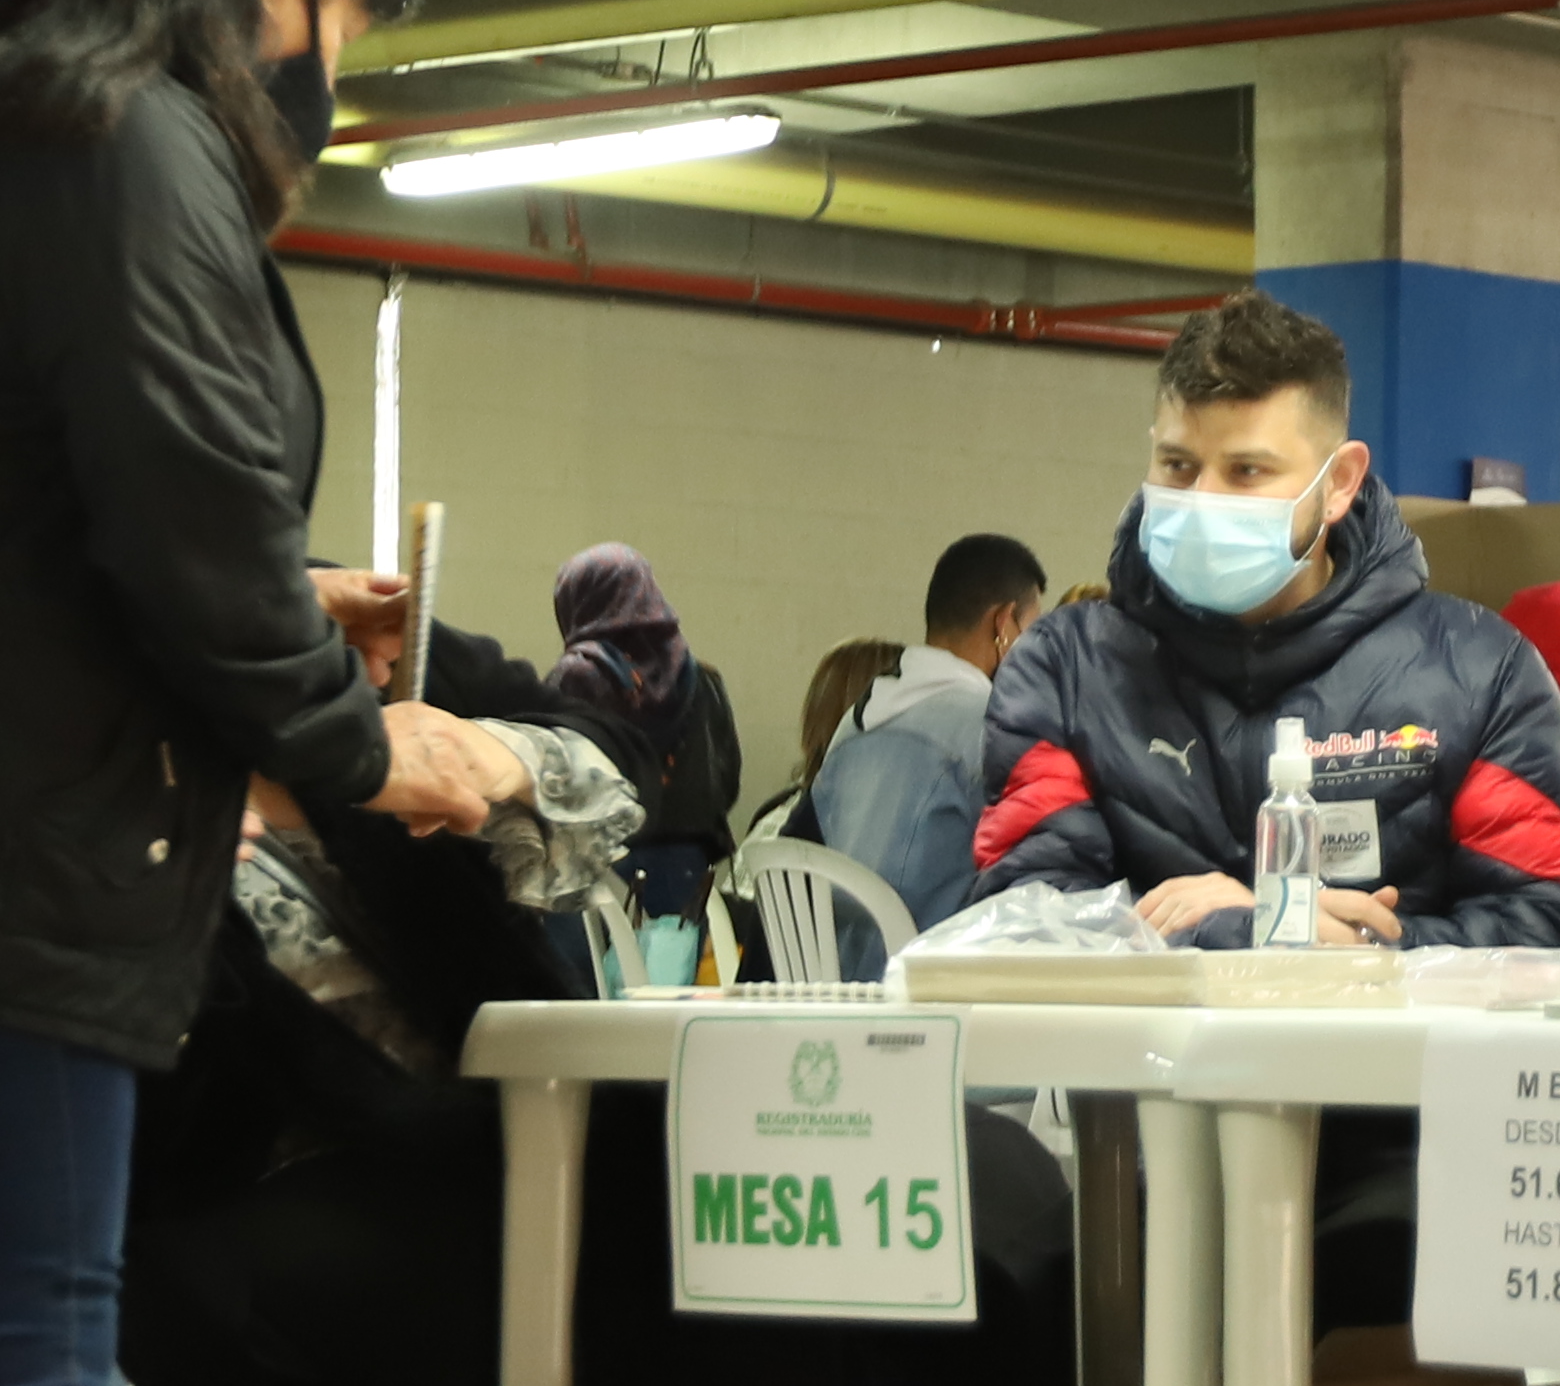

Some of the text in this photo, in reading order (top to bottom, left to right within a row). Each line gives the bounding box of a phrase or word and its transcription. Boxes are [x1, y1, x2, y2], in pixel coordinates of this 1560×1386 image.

[1338, 728, 1375, 755] Bull
[693, 1173, 943, 1250] MESA 15
